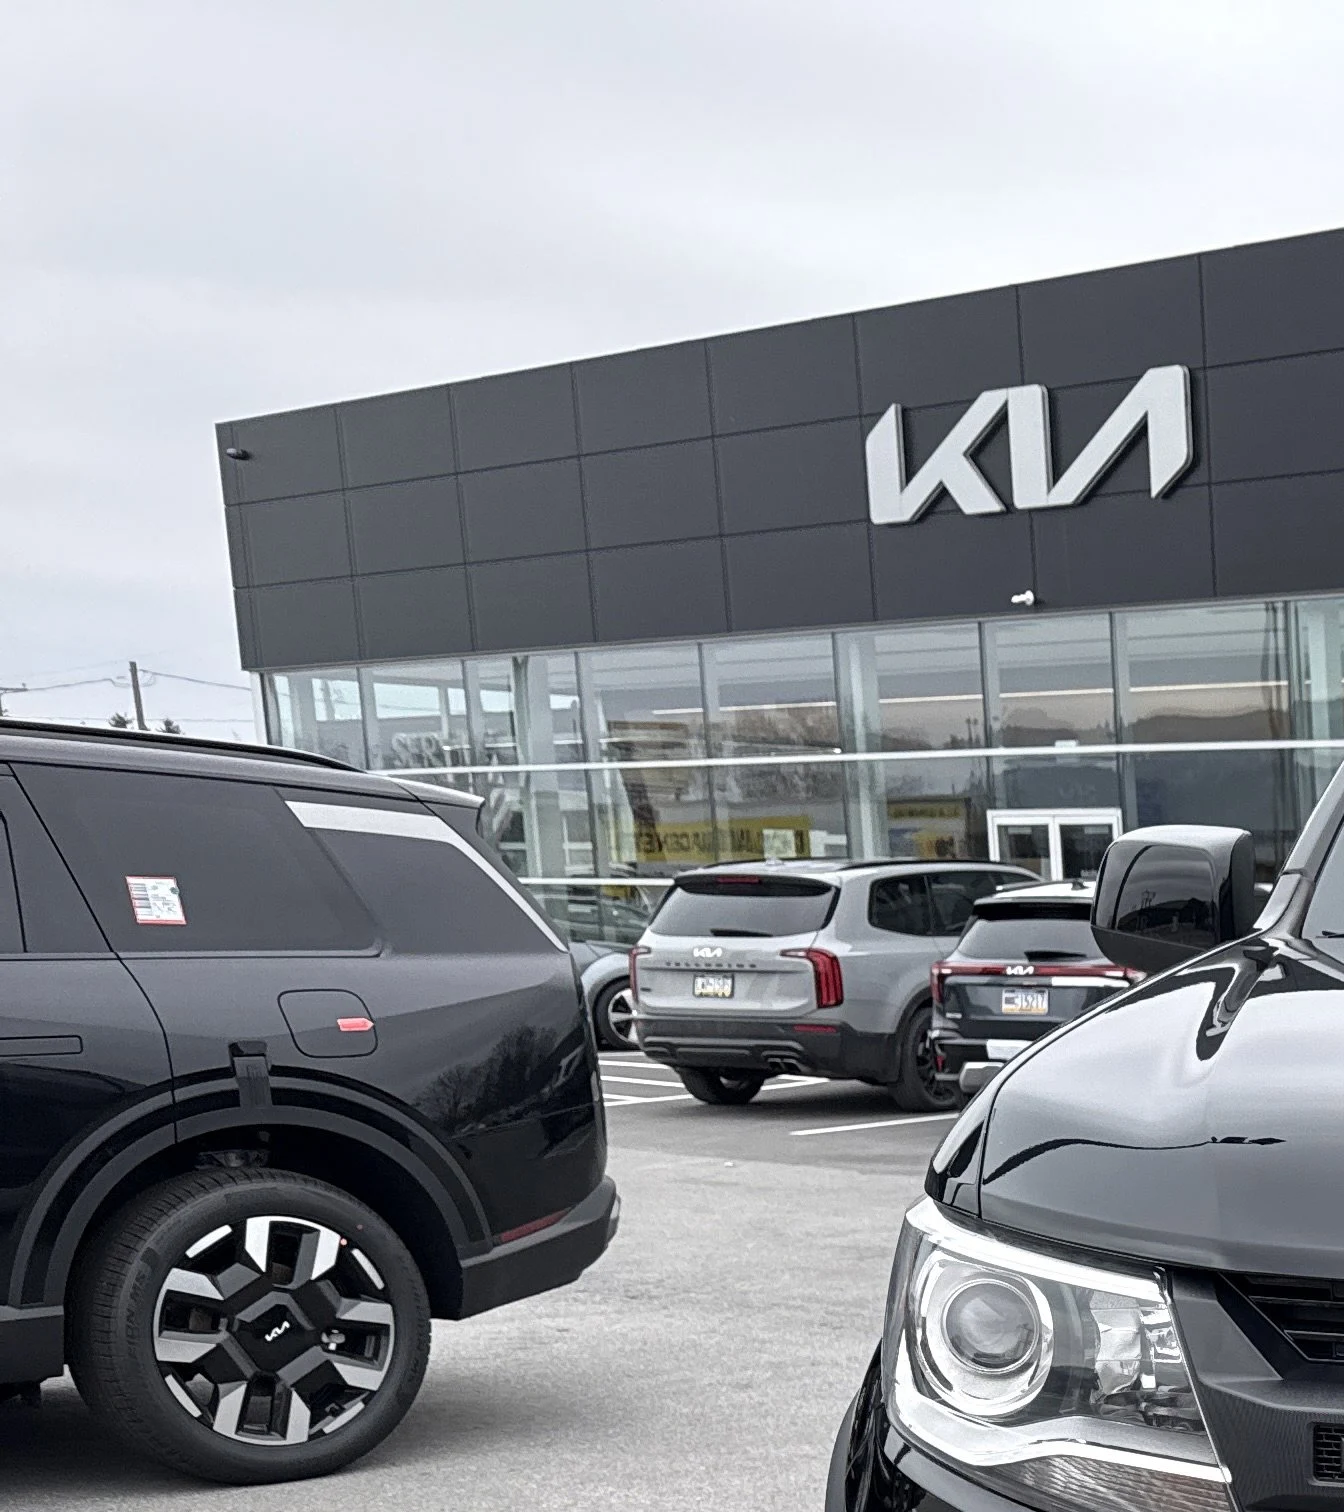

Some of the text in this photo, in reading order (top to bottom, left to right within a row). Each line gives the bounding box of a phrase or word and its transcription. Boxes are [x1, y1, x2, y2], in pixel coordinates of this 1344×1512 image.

[865, 364, 1192, 526] KIA
[692, 947, 722, 958] KIA
[1005, 965, 1035, 976] KIA
